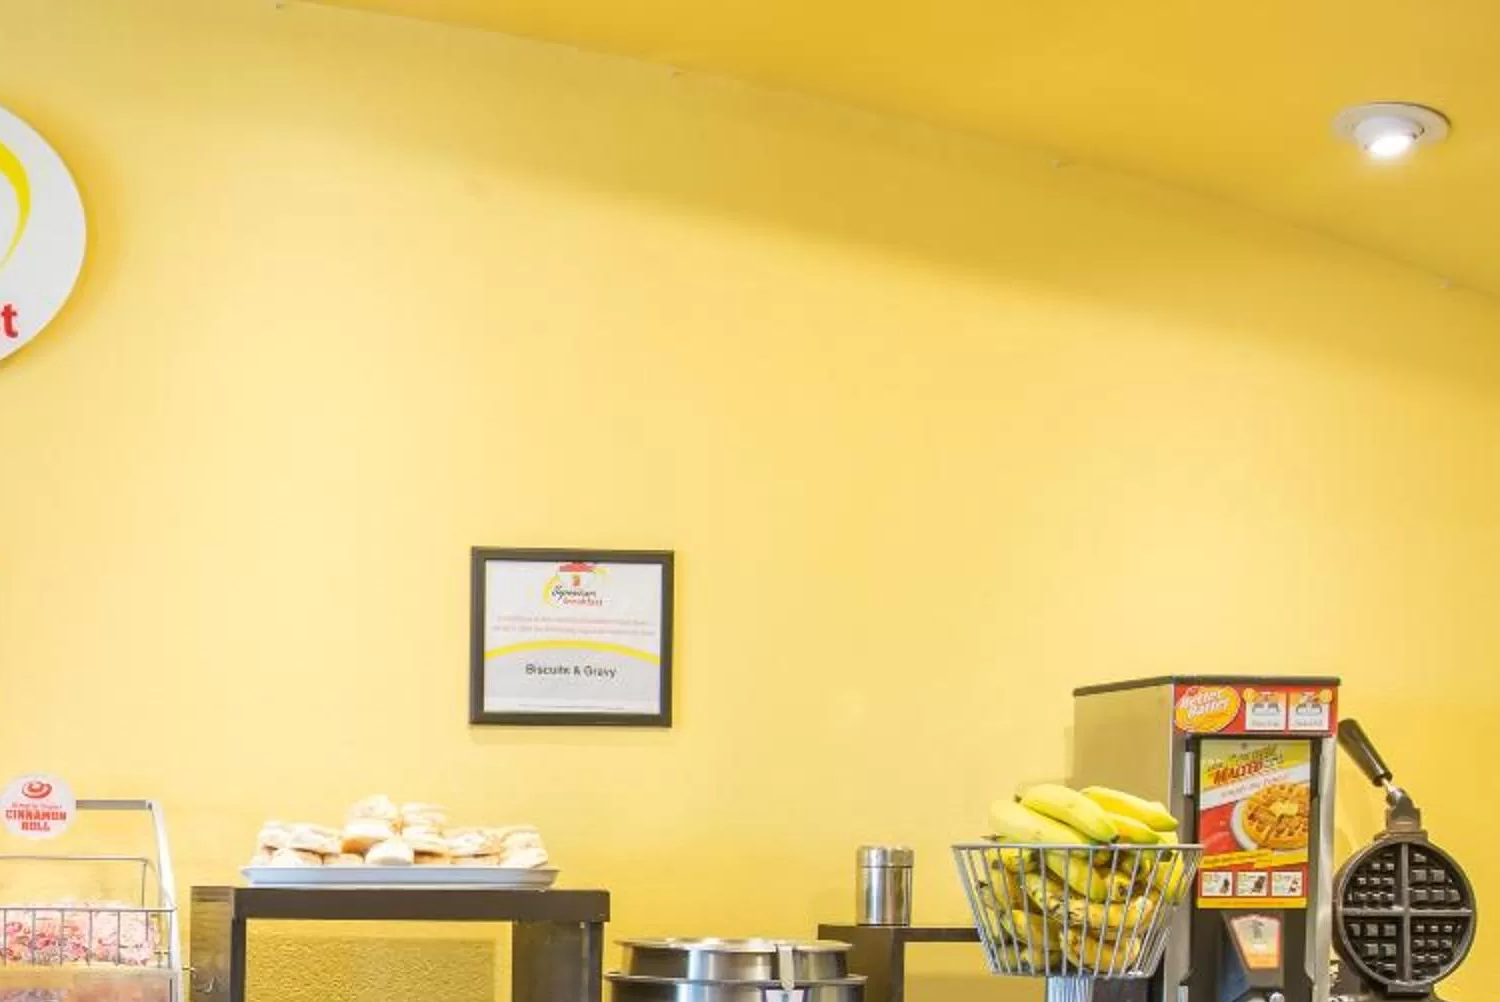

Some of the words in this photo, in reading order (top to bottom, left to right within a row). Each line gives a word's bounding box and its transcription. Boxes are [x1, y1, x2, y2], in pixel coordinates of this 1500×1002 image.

[525, 663, 570, 676] Biscuits
[583, 665, 617, 678] Gravy
[5, 809, 66, 821] CINNAMON
[21, 821, 50, 832] ROLL
